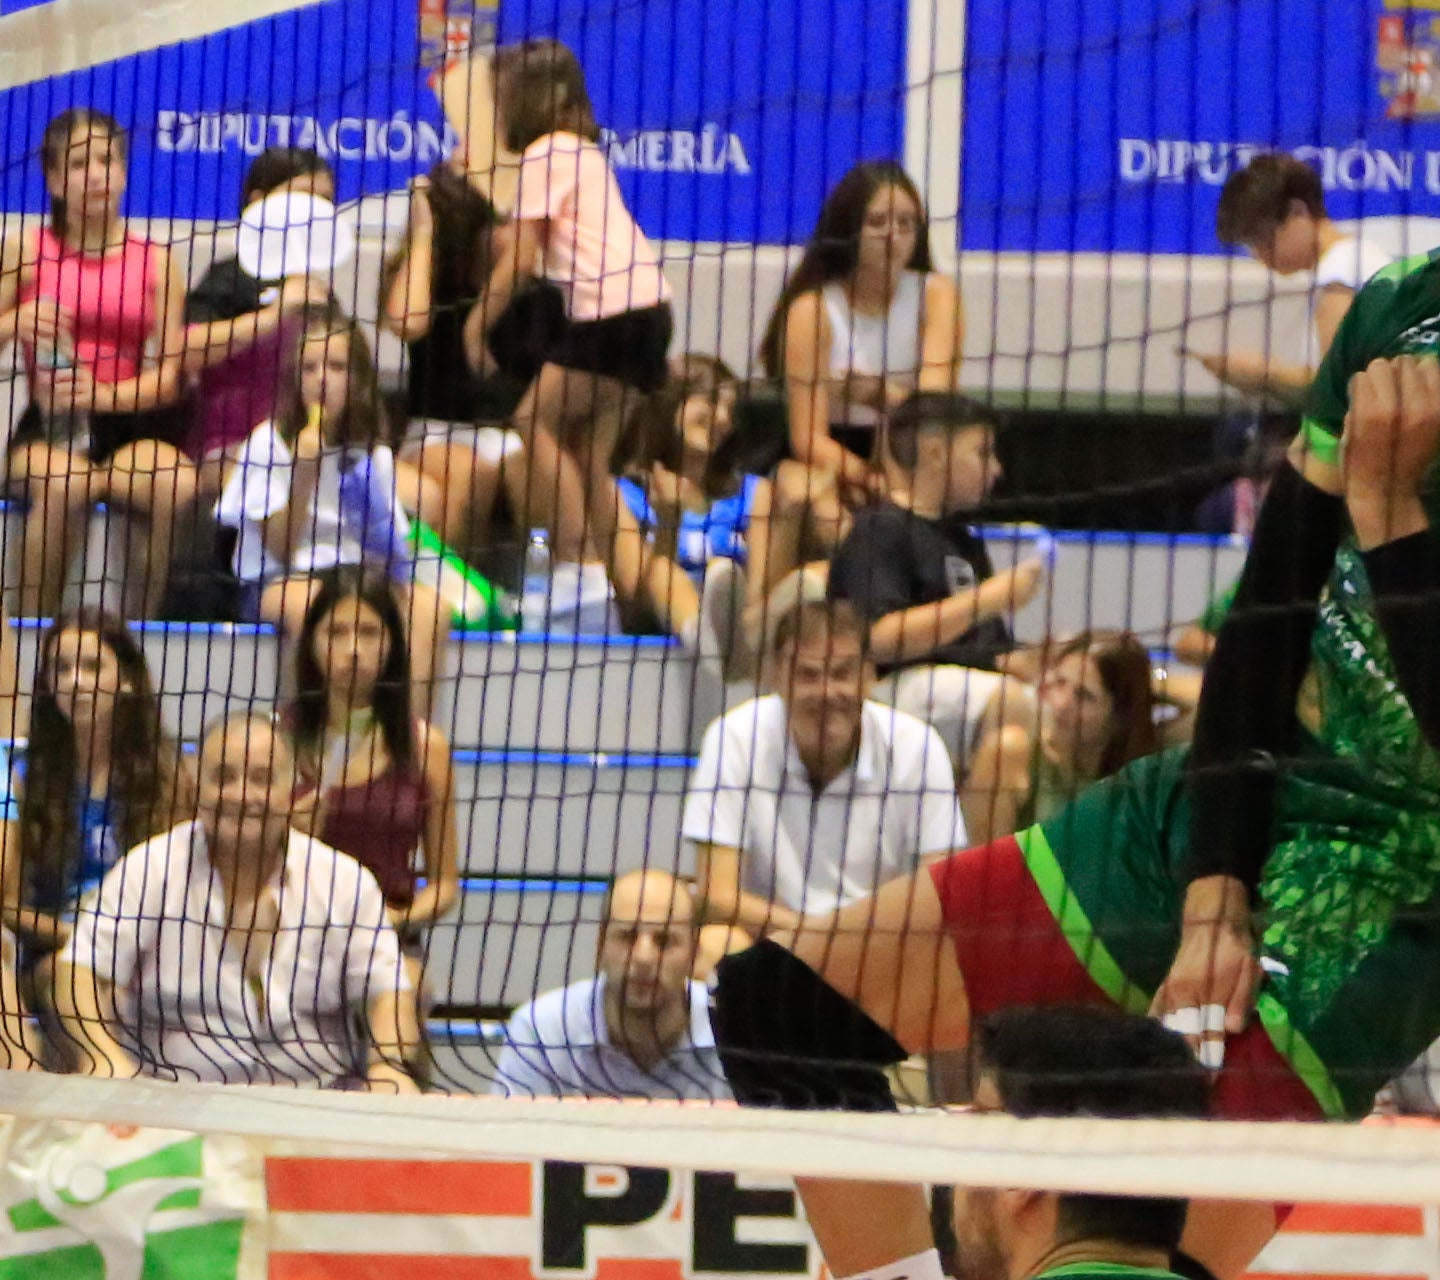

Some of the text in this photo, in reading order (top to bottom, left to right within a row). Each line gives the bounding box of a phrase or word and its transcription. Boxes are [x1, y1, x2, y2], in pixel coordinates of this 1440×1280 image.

[157, 108, 752, 174] DIPUTACIÓN MERÍA
[1118, 136, 1415, 193] DIPUTIÓN
